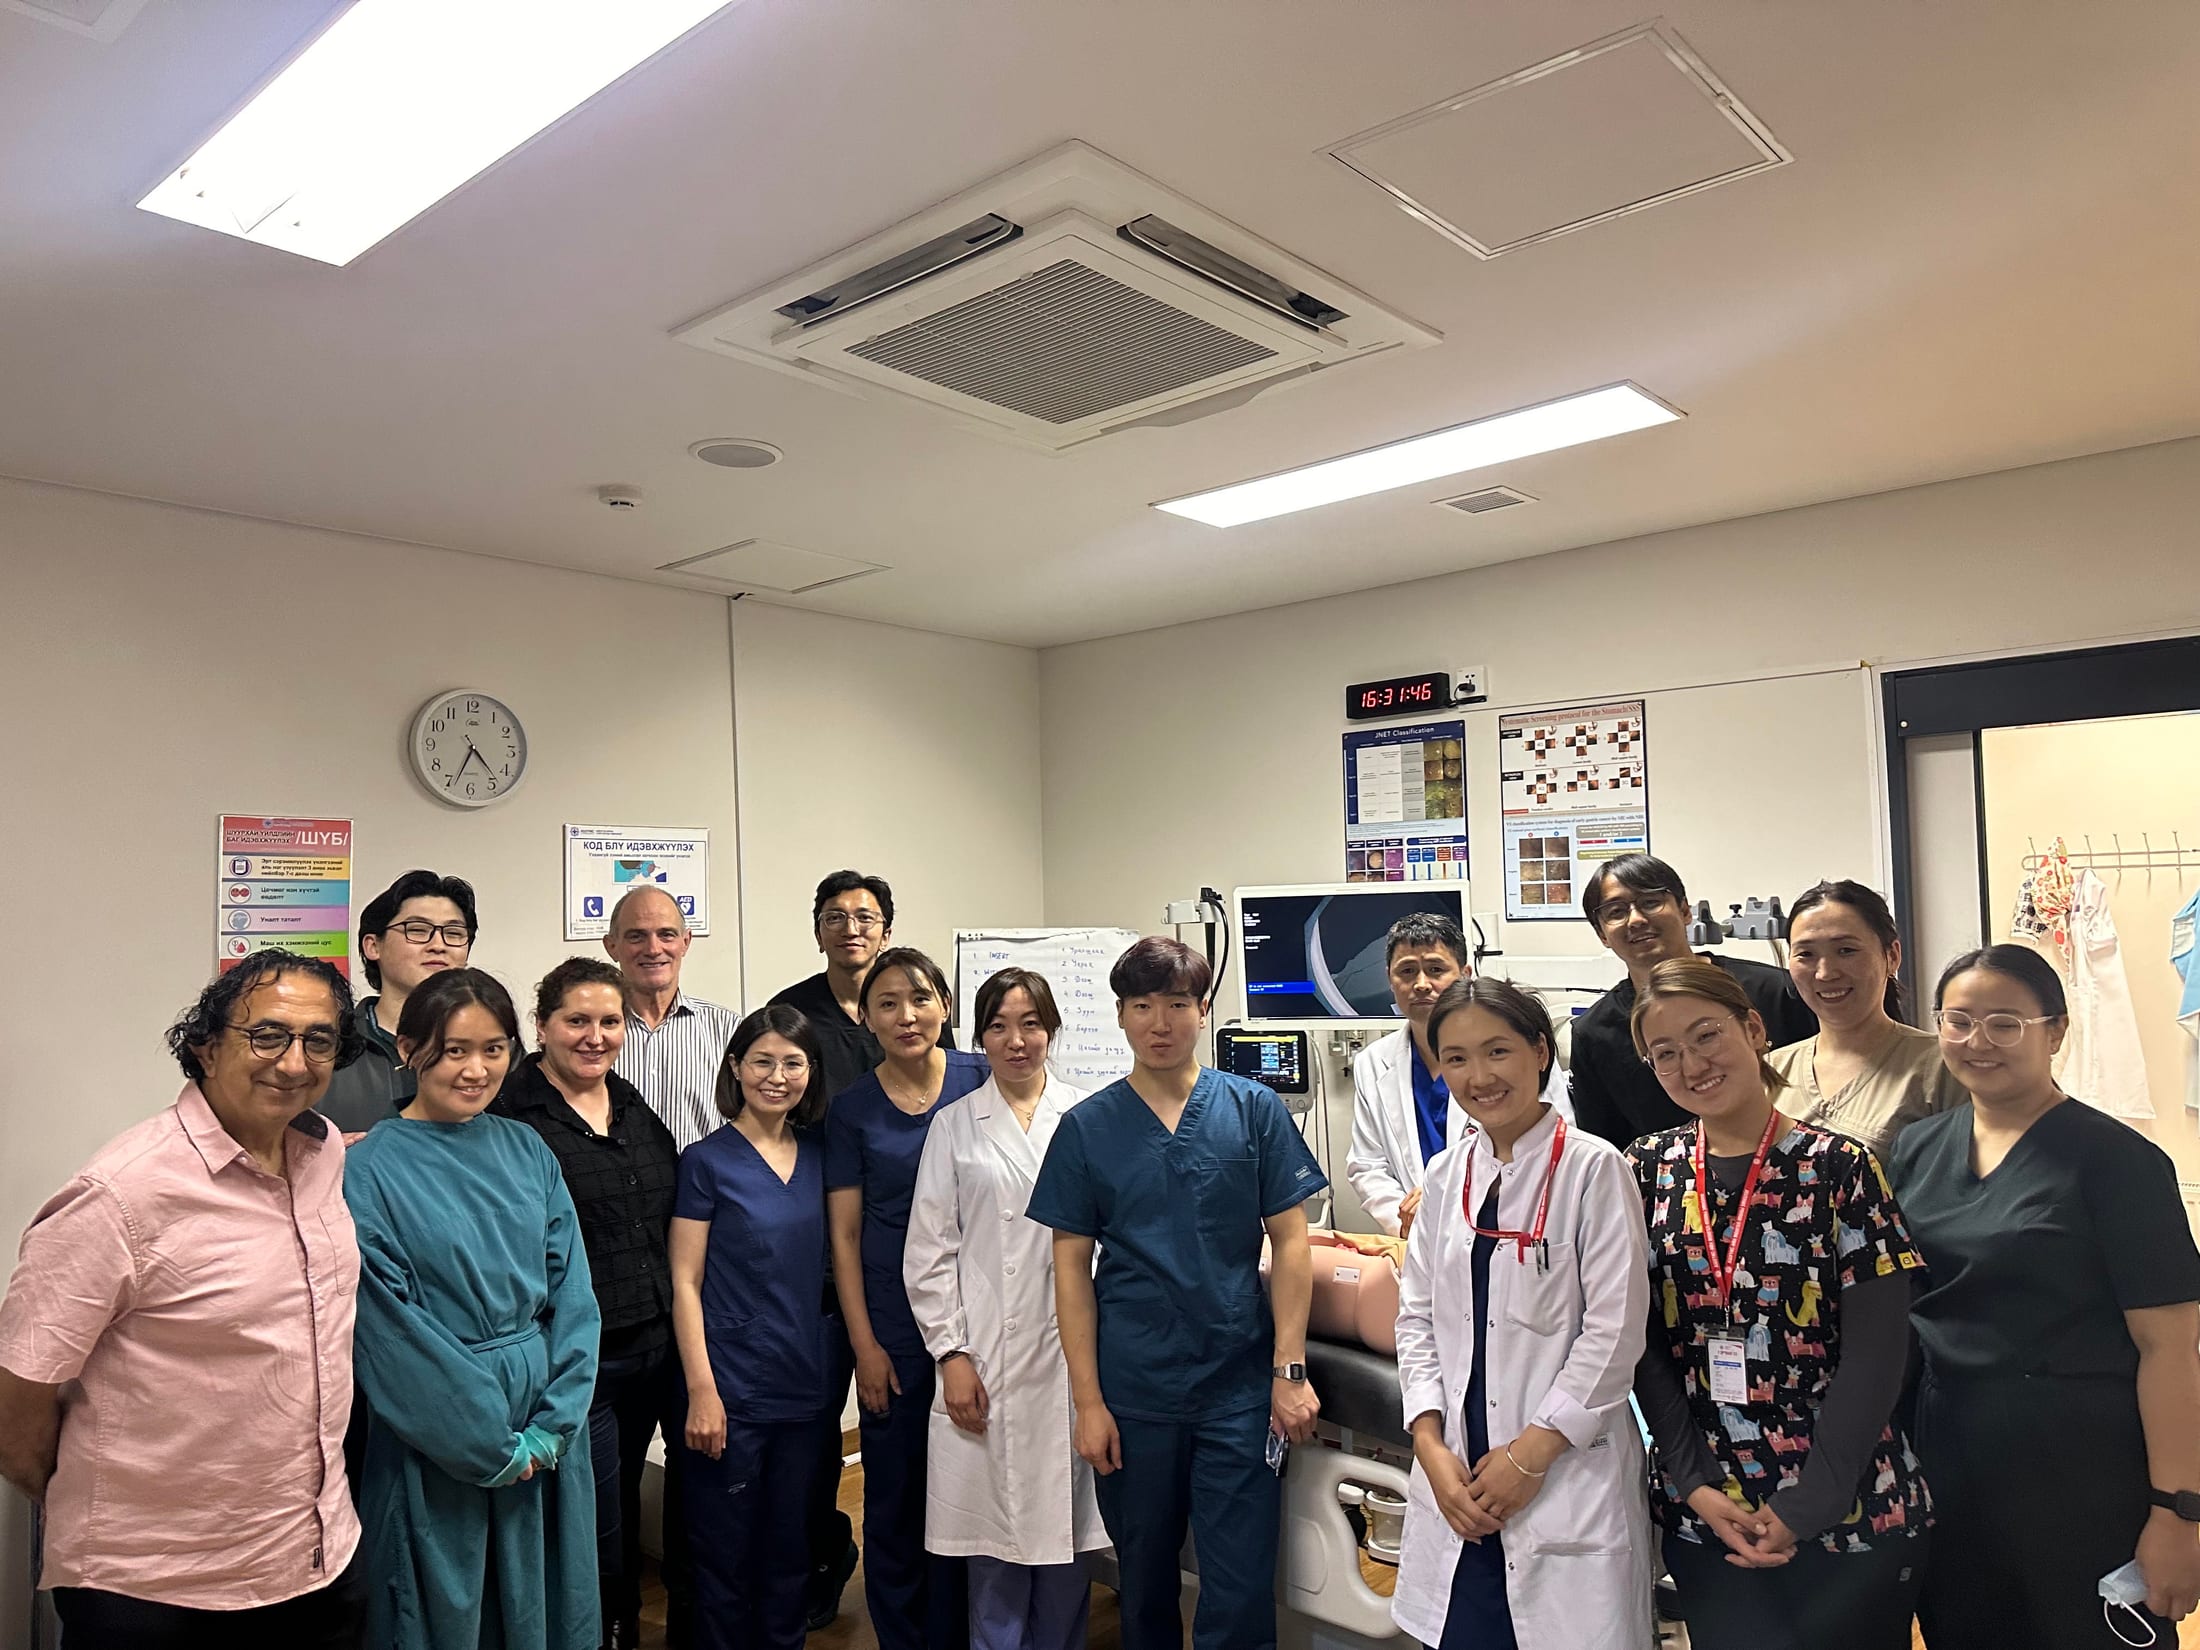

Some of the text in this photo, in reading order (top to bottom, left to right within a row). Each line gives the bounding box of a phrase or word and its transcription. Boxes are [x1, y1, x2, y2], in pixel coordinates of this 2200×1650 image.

[1361, 683, 1432, 708] 16:31:46
[466, 700, 480, 713] 12
[446, 707, 455, 720] 11
[491, 711, 496, 724] 1
[1530, 714, 1557, 723] Screening
[1558, 711, 1581, 721] protocol
[1582, 709, 1591, 717] for
[1592, 708, 1601, 716] the
[431, 719, 445, 732] 10
[501, 726, 510, 738] 2
[1375, 727, 1435, 739] JNET Classification
[425, 738, 436, 751] 9
[506, 745, 516, 758] 3
[431, 757, 441, 771] 8
[499, 763, 509, 777] 4
[444, 774, 454, 787] 7
[487, 777, 497, 790] 5
[466, 782, 475, 796] 6
[583, 841, 695, 852] КОД БЛҮ ИДЭВХЖҮҮЛЭХ
